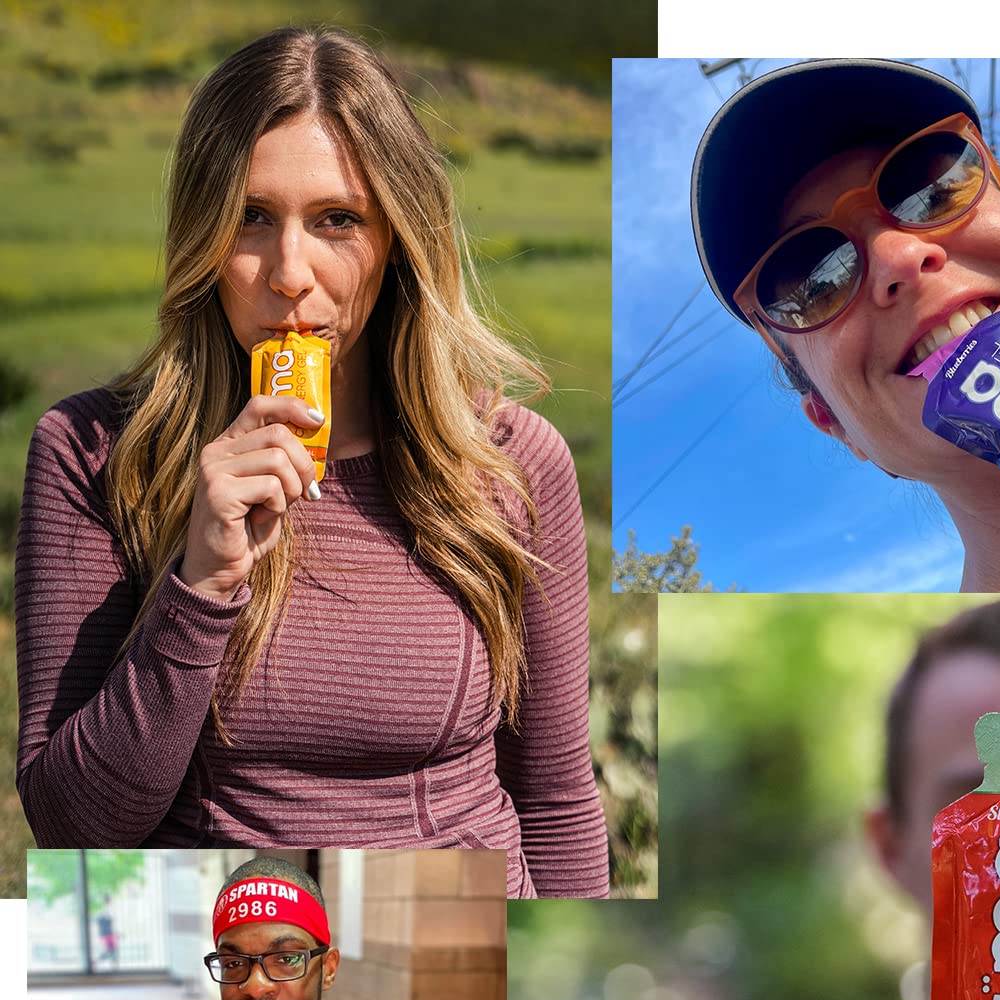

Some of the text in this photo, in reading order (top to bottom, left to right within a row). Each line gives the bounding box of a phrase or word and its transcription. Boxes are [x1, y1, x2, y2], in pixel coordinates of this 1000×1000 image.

[945, 339, 978, 379] Blueberries
[229, 882, 298, 903] SPARTAN
[228, 901, 277, 923] 2986
